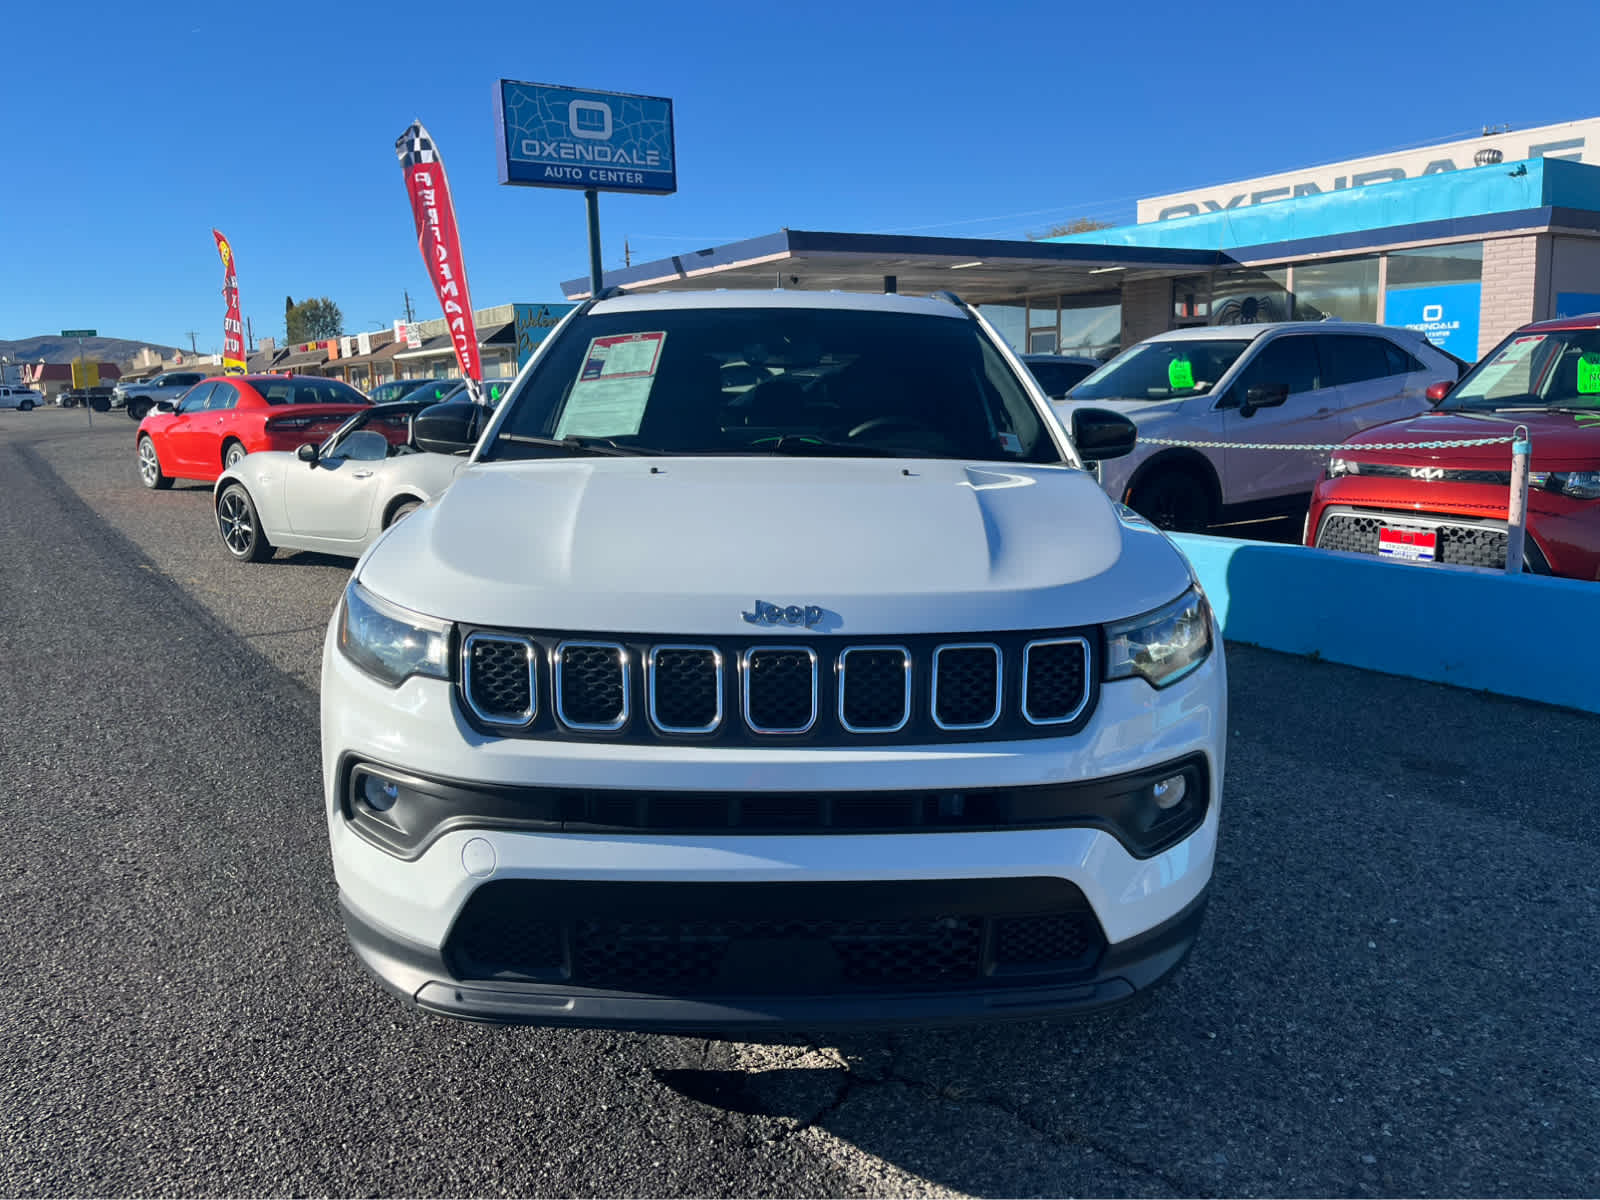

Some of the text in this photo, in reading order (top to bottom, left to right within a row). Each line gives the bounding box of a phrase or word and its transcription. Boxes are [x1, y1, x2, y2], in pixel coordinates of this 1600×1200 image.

[521, 139, 661, 166] OXENDALE
[544, 166, 644, 184] AUTO CENTER
[741, 599, 823, 629] Jeep
